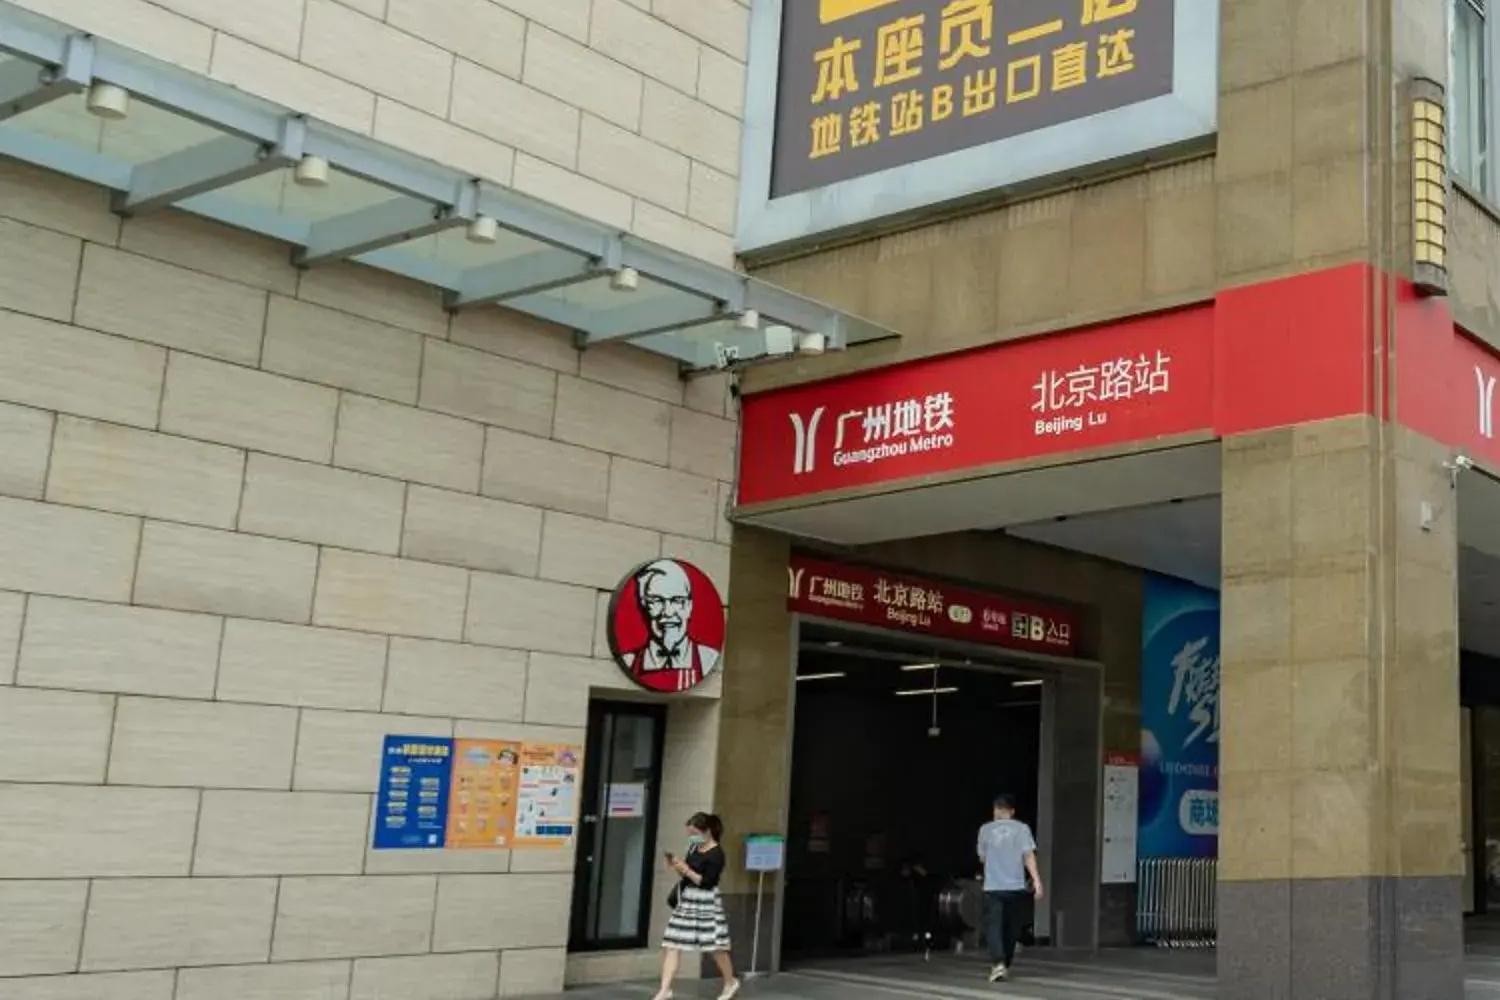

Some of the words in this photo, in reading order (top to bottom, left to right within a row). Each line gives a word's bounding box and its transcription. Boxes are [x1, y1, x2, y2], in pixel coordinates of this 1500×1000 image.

[808, 27, 1136, 159] 地铁站B出口直达
[1031, 350, 1170, 413] 北京路站
[834, 391, 954, 449] 广州地铁
[1035, 417, 1083, 436] Beijing
[1088, 411, 1107, 426] Lu
[833, 442, 907, 467] Guangzhou
[909, 433, 954, 455] Metro
[808, 575, 865, 601] 广州地铁
[872, 577, 944, 614] 北京路站
[886, 606, 917, 627] Beijing
[917, 612, 931, 627] Lu
[1030, 615, 1044, 641] B
[1046, 618, 1070, 639] 入口
